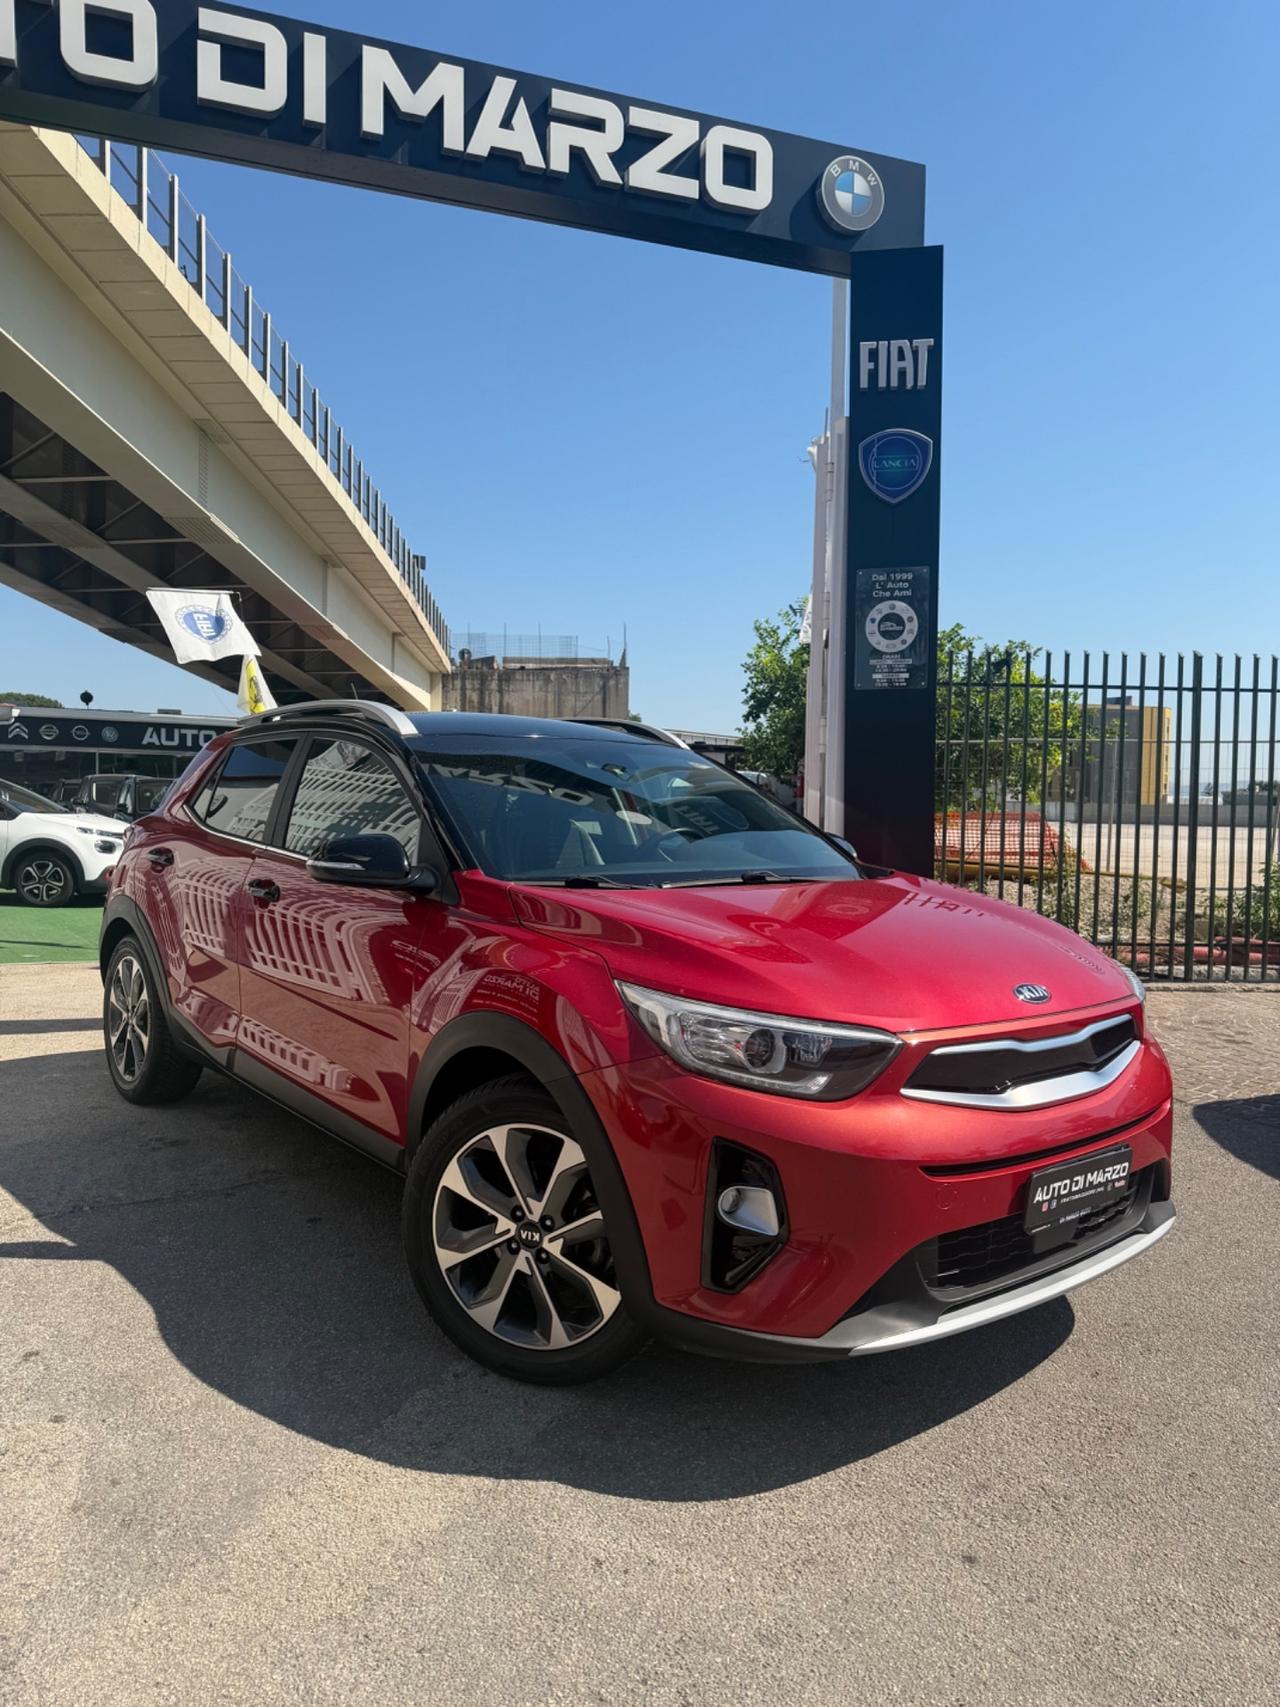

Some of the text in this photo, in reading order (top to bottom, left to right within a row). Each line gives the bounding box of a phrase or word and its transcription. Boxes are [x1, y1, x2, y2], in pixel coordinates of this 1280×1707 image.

[197, 7, 327, 124] DI
[361, 44, 774, 212] MARZO
[830, 159, 878, 186] BMW
[859, 338, 934, 389] FIAT
[875, 458, 918, 469] LANCIA
[890, 572, 913, 580] 1999
[887, 581, 909, 589] Auto
[893, 589, 912, 597] Ami
[142, 726, 217, 747] AUTO
[1018, 985, 1048, 1000] KIA
[1033, 1179, 1071, 1204] AUTO
[1071, 1174, 1086, 1192] DI
[1085, 1161, 1129, 1188] MARZO
[520, 1230, 540, 1243] KIA
